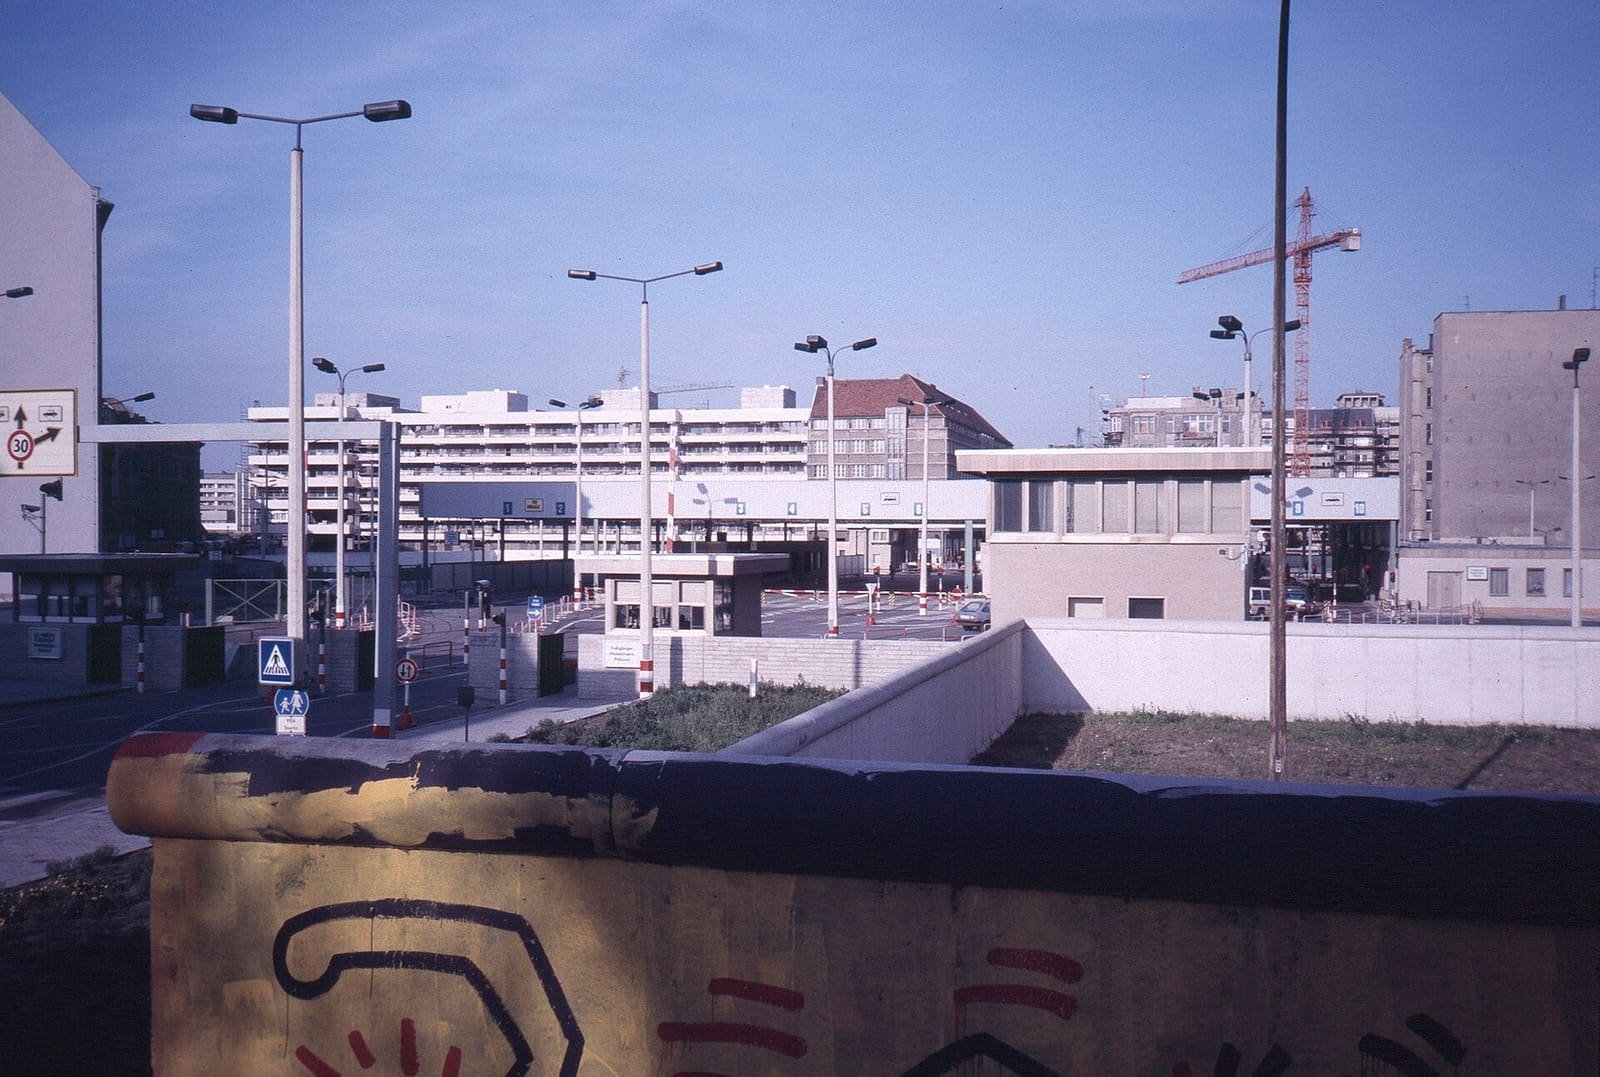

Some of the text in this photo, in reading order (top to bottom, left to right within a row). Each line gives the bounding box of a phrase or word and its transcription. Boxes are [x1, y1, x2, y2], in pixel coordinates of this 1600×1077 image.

[13, 439, 29, 453] 30
[788, 503, 796, 514] 4
[862, 503, 869, 515] 5
[1355, 503, 1365, 514] 10
